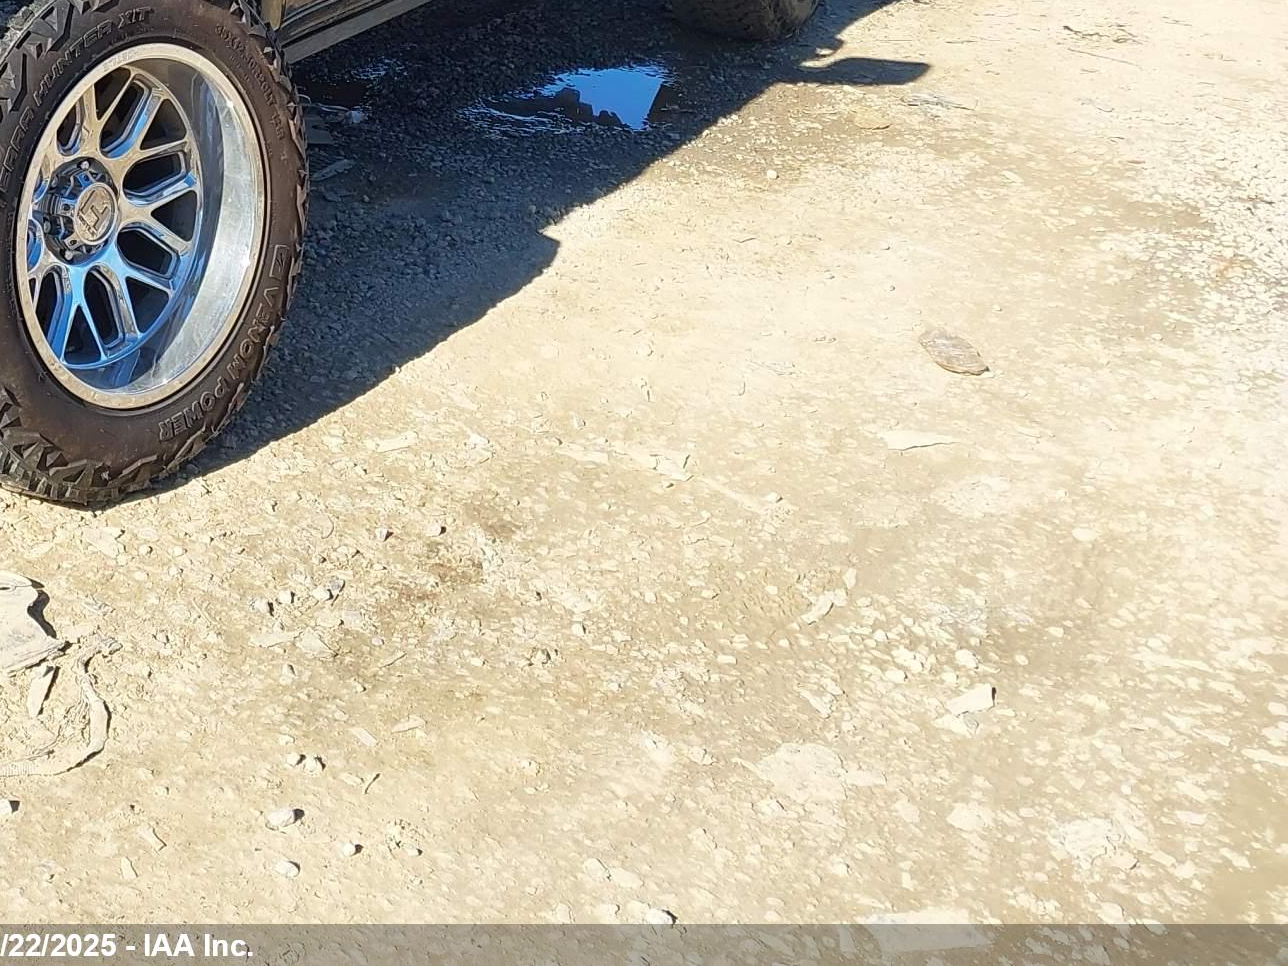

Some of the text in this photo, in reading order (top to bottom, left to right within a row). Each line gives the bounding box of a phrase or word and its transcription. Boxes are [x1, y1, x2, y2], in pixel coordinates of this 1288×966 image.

[33, 19, 112, 107] HUNTER
[159, 286, 280, 442] VENOM POWER
